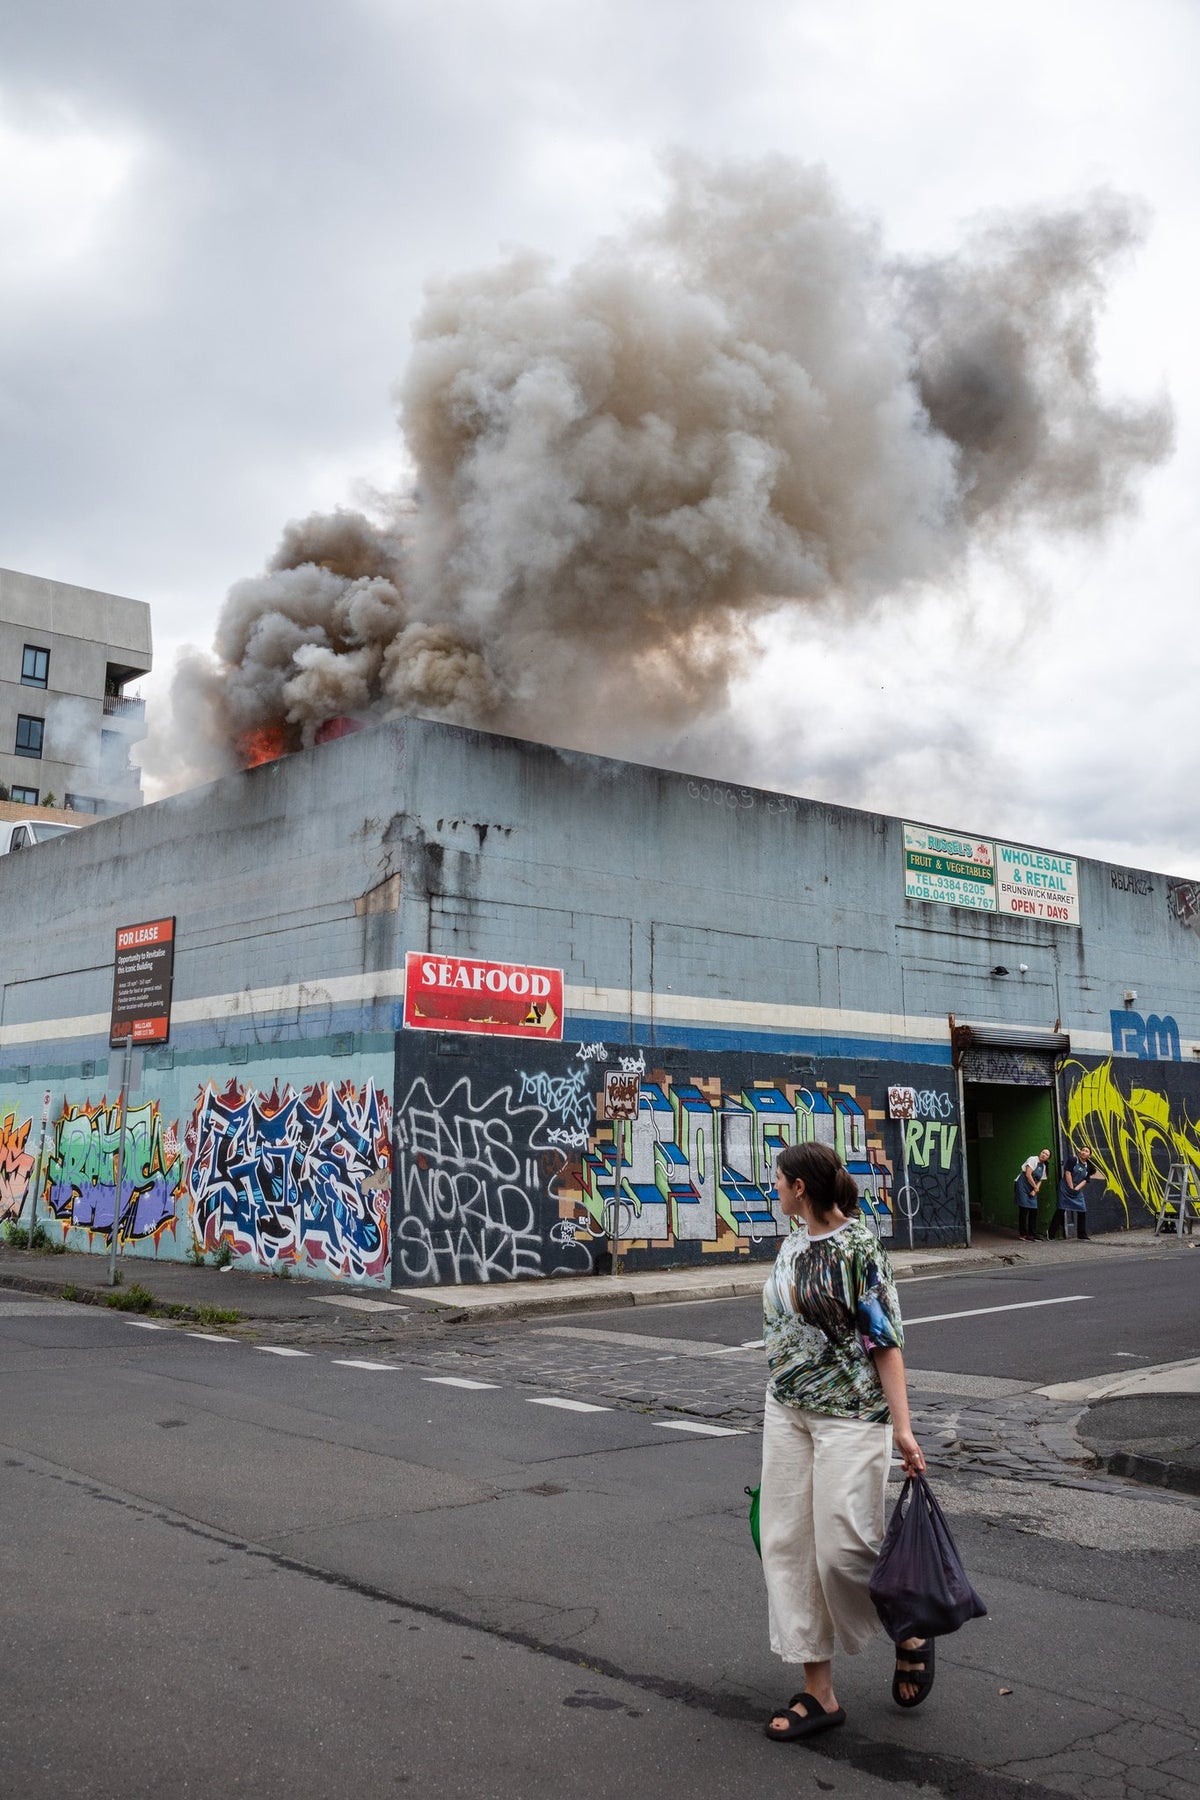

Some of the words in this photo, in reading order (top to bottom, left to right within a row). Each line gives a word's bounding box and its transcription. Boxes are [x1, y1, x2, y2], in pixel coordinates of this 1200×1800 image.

[910, 854, 932, 868] FRUIT
[935, 859, 942, 870] &
[946, 861, 991, 879] VEGETABLES
[1001, 847, 1073, 875] WHOLESALE
[915, 873, 961, 891] TEL.9384
[962, 882, 985, 896] 6205
[1013, 868, 1021, 883] &
[1026, 871, 1067, 891] RETAIL
[907, 884, 956, 902] MOB.0419
[958, 893, 976, 906] 564
[977, 897, 994, 909] 767
[1001, 883, 1047, 900] BRUNSWICK
[1047, 892, 1075, 905] MARKET
[1011, 899, 1036, 914] OPEN
[1038, 903, 1044, 916] 7
[1047, 905, 1069, 921] DAYS
[118, 932, 134, 947] FOR
[135, 927, 159, 943] LEASE
[117, 966, 125, 975] this
[137, 962, 153, 971] Building
[118, 953, 140, 965] Opportunity
[141, 952, 146, 960] to
[422, 962, 551, 997] SEAFOOD
[905, 1120, 959, 1170] RFV
[400, 1152, 535, 1235] WORLD
[398, 1215, 547, 1284] SHAKE
